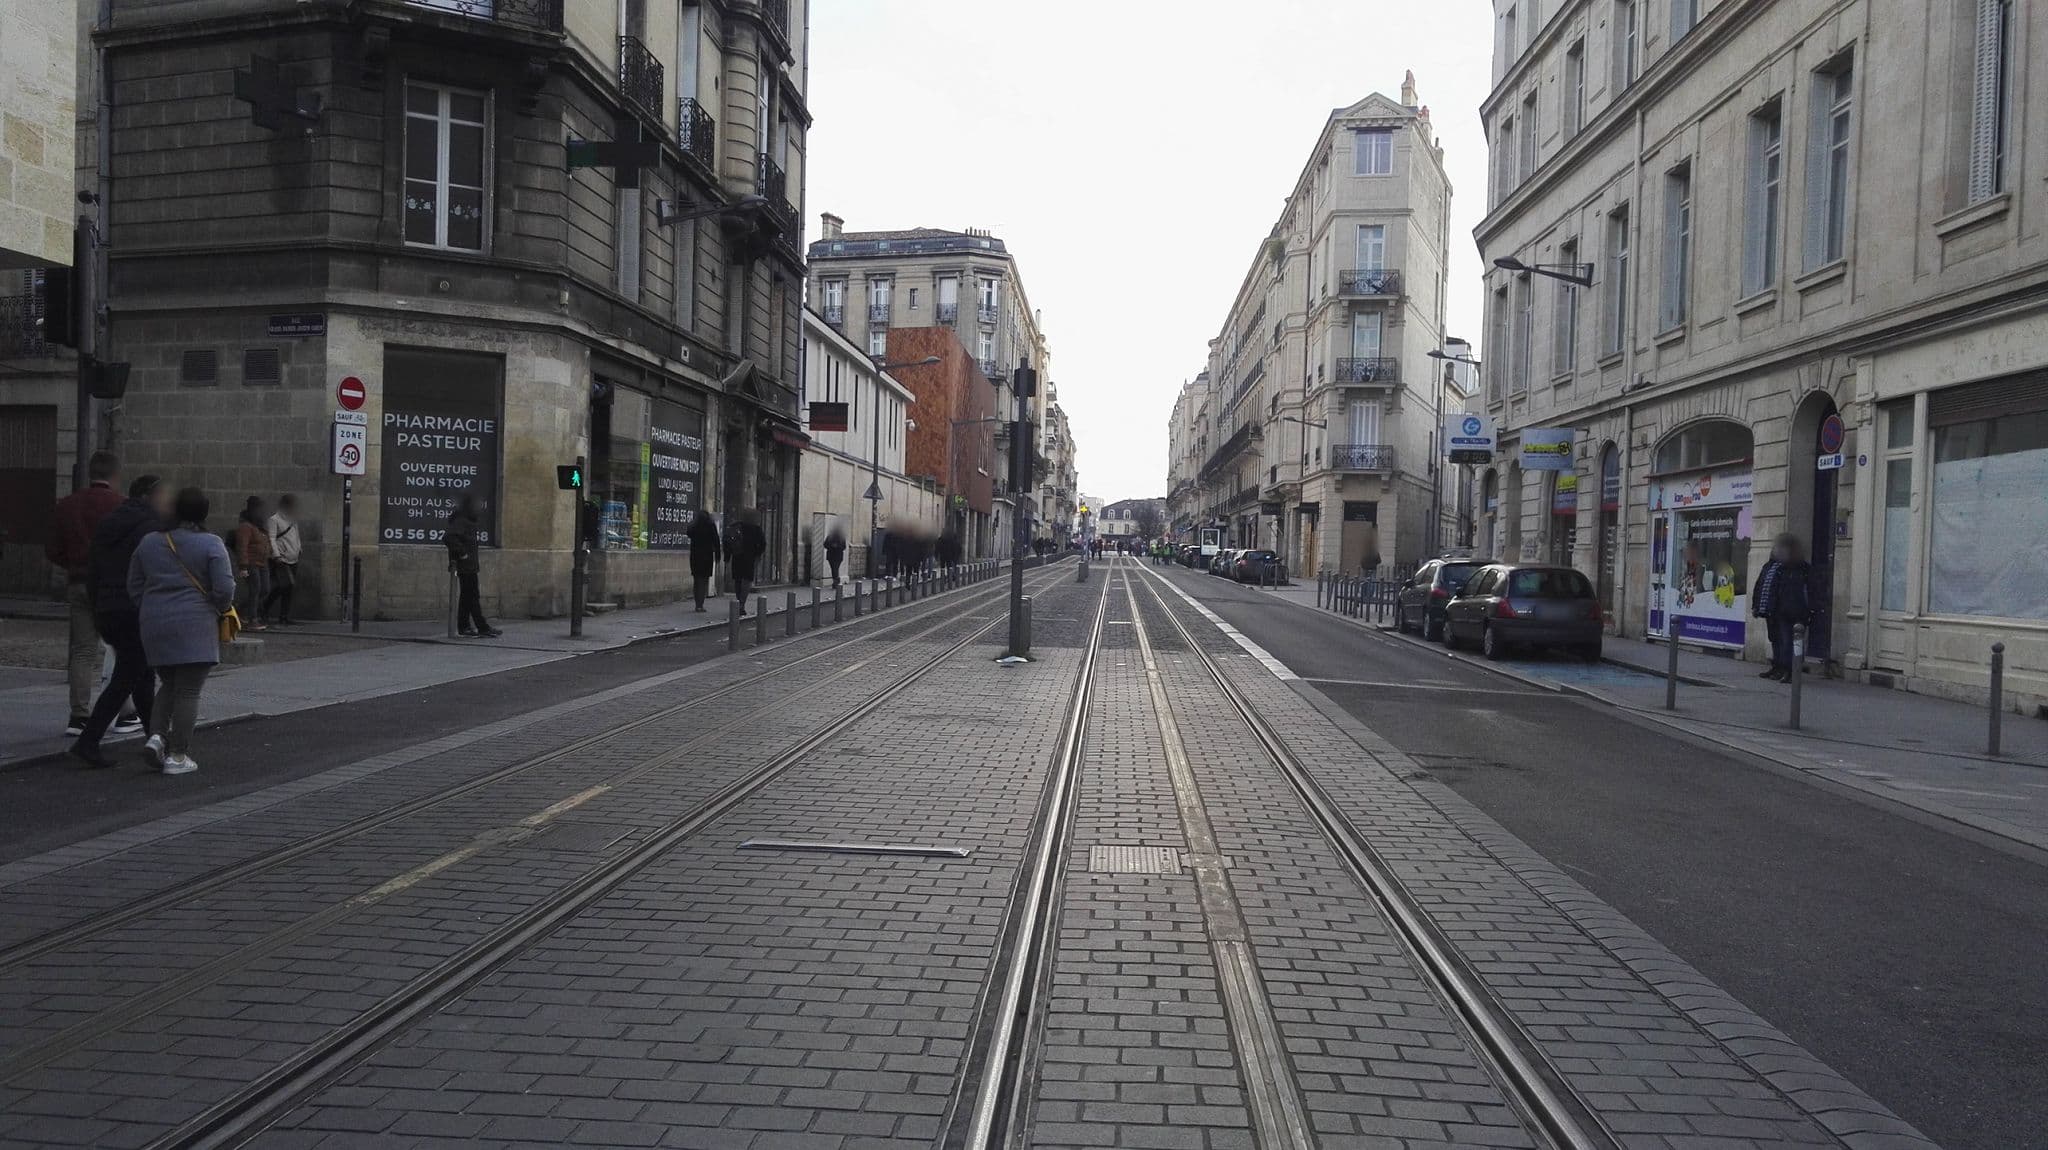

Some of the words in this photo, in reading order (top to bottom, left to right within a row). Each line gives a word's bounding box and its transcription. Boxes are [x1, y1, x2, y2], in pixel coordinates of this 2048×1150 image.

[337, 413, 353, 421] SAUF
[384, 413, 495, 433] PHARMACIE
[340, 430, 362, 439] ZONE
[651, 426, 681, 446] PHARMACIE
[681, 433, 702, 450] PASTEUR
[397, 433, 481, 451] PASTEUR
[400, 462, 478, 475] OUVERTURE
[652, 453, 679, 471] OUVERTURE
[679, 458, 689, 472] NON
[689, 460, 700, 474] STOP
[1819, 457, 1833, 467] SAUF
[406, 476, 435, 487] NON
[438, 477, 471, 488] STOP
[658, 477, 671, 489] LUNDI
[672, 479, 678, 490] AU
[387, 496, 422, 506] LUNDI
[425, 498, 442, 507] AU
[408, 508, 423, 518] 9H
[657, 507, 665, 521] 05
[665, 508, 672, 521] 56
[673, 508, 679, 522] 92
[384, 527, 403, 539] 05
[407, 528, 425, 540] 56
[650, 529, 658, 544] La
